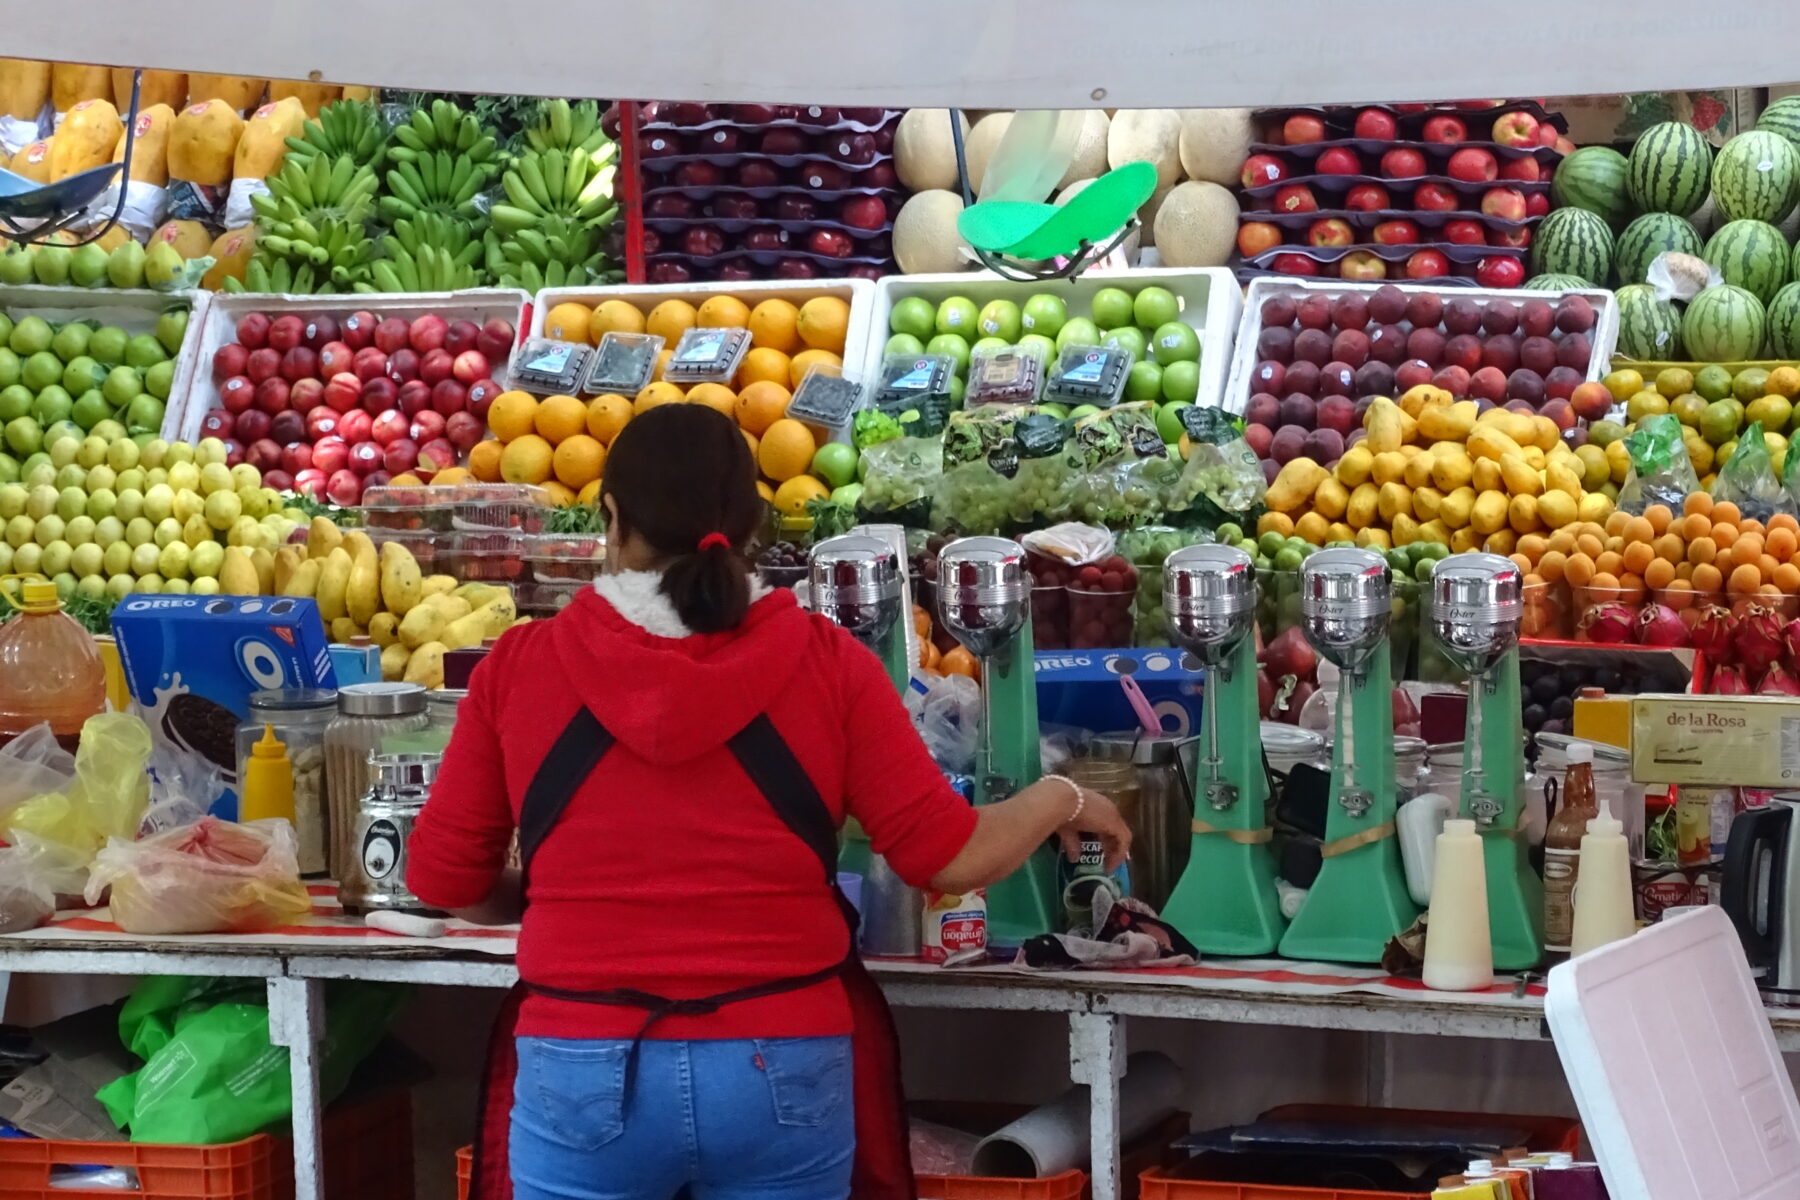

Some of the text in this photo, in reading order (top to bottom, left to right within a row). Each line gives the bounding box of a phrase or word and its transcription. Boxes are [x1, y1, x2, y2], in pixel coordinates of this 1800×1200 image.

[126, 599, 197, 612] OREO
[1318, 603, 1344, 614] Oster
[1449, 607, 1476, 619] Oster
[1034, 656, 1091, 672] REO
[1666, 711, 1746, 728] de la Rosa
[1079, 852, 1105, 866] ecaf
